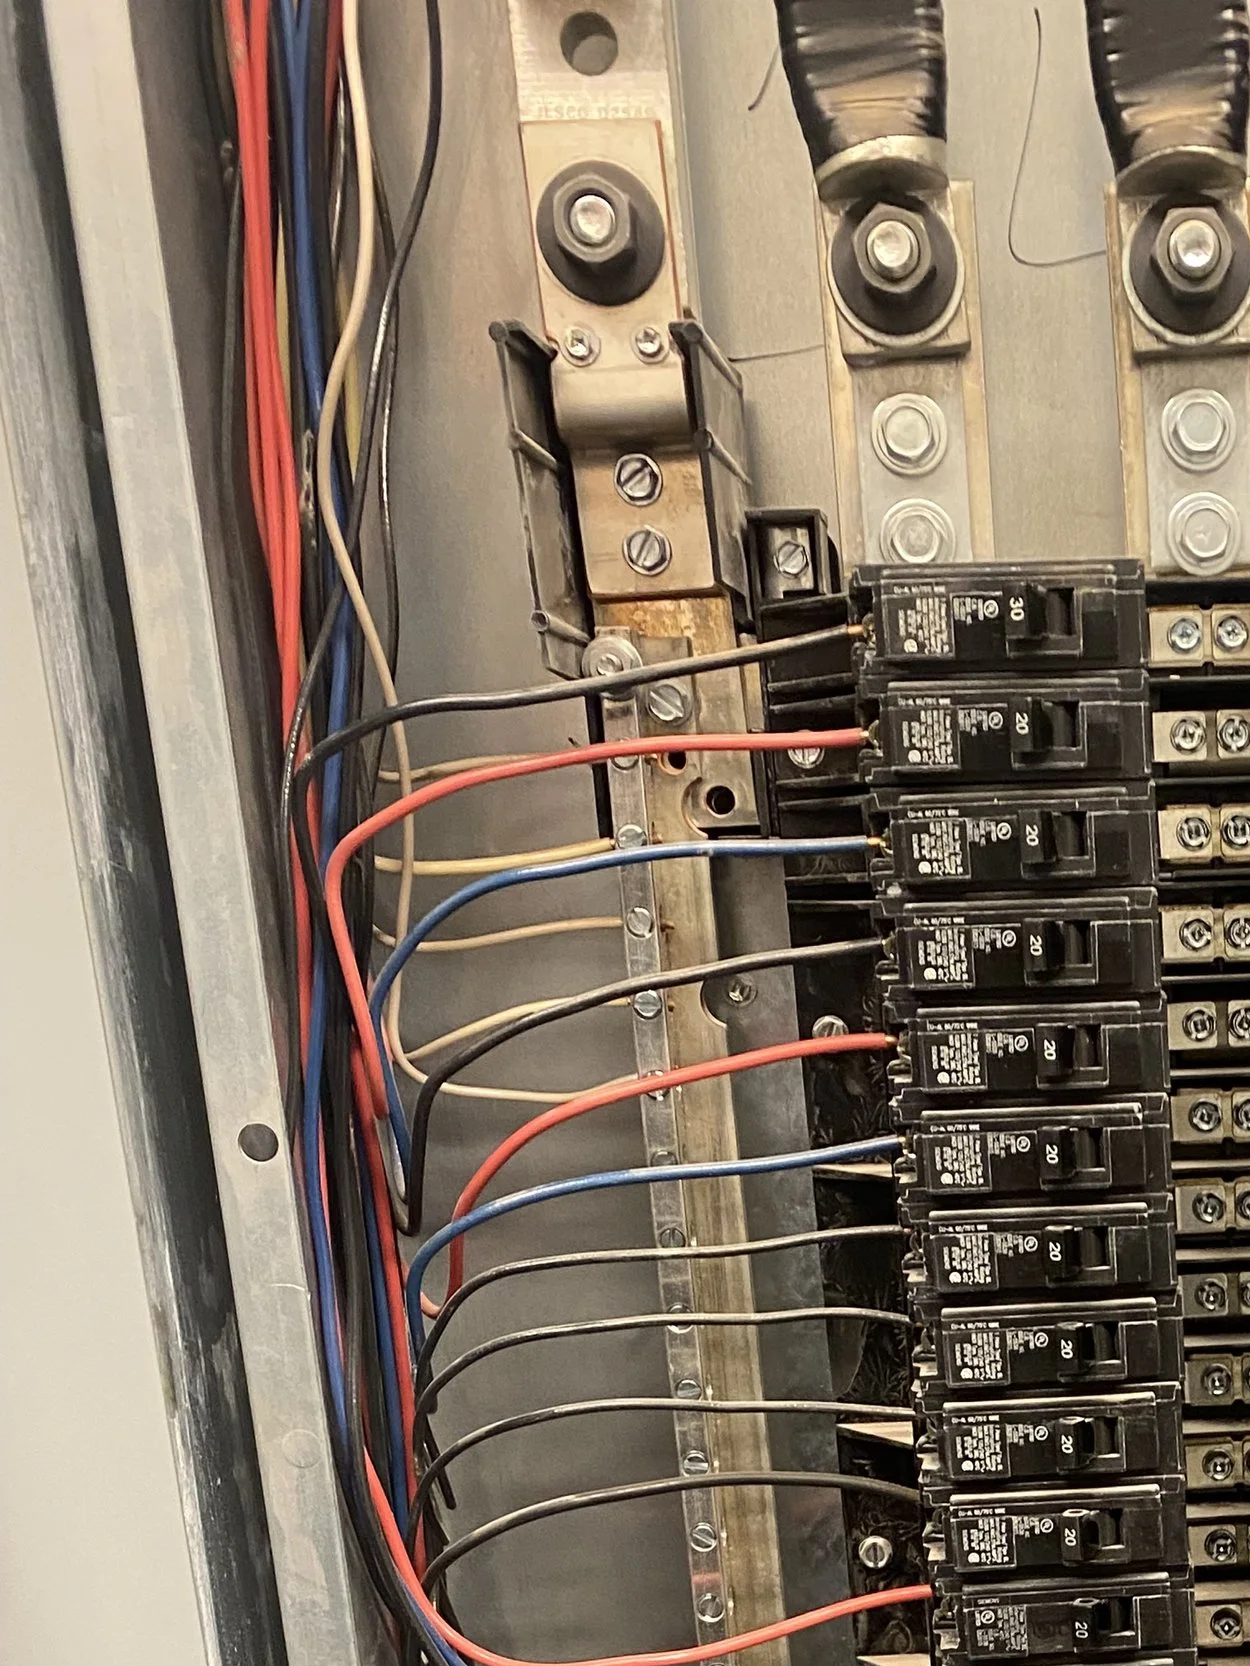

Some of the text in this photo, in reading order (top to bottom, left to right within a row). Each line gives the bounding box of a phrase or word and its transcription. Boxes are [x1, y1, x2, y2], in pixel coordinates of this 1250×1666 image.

[1010, 598, 1025, 621] 30
[1016, 713, 1029, 735] 20
[1026, 825, 1039, 847] 20
[1030, 935, 1043, 957] 20
[1044, 1040, 1057, 1061] 20
[1046, 1144, 1059, 1165] 20
[1049, 1242, 1062, 1262] 20
[1061, 1339, 1074, 1359] 20
[1062, 1435, 1074, 1454] 20
[1065, 1528, 1077, 1547] 20
[1075, 1622, 1089, 1639] 20
